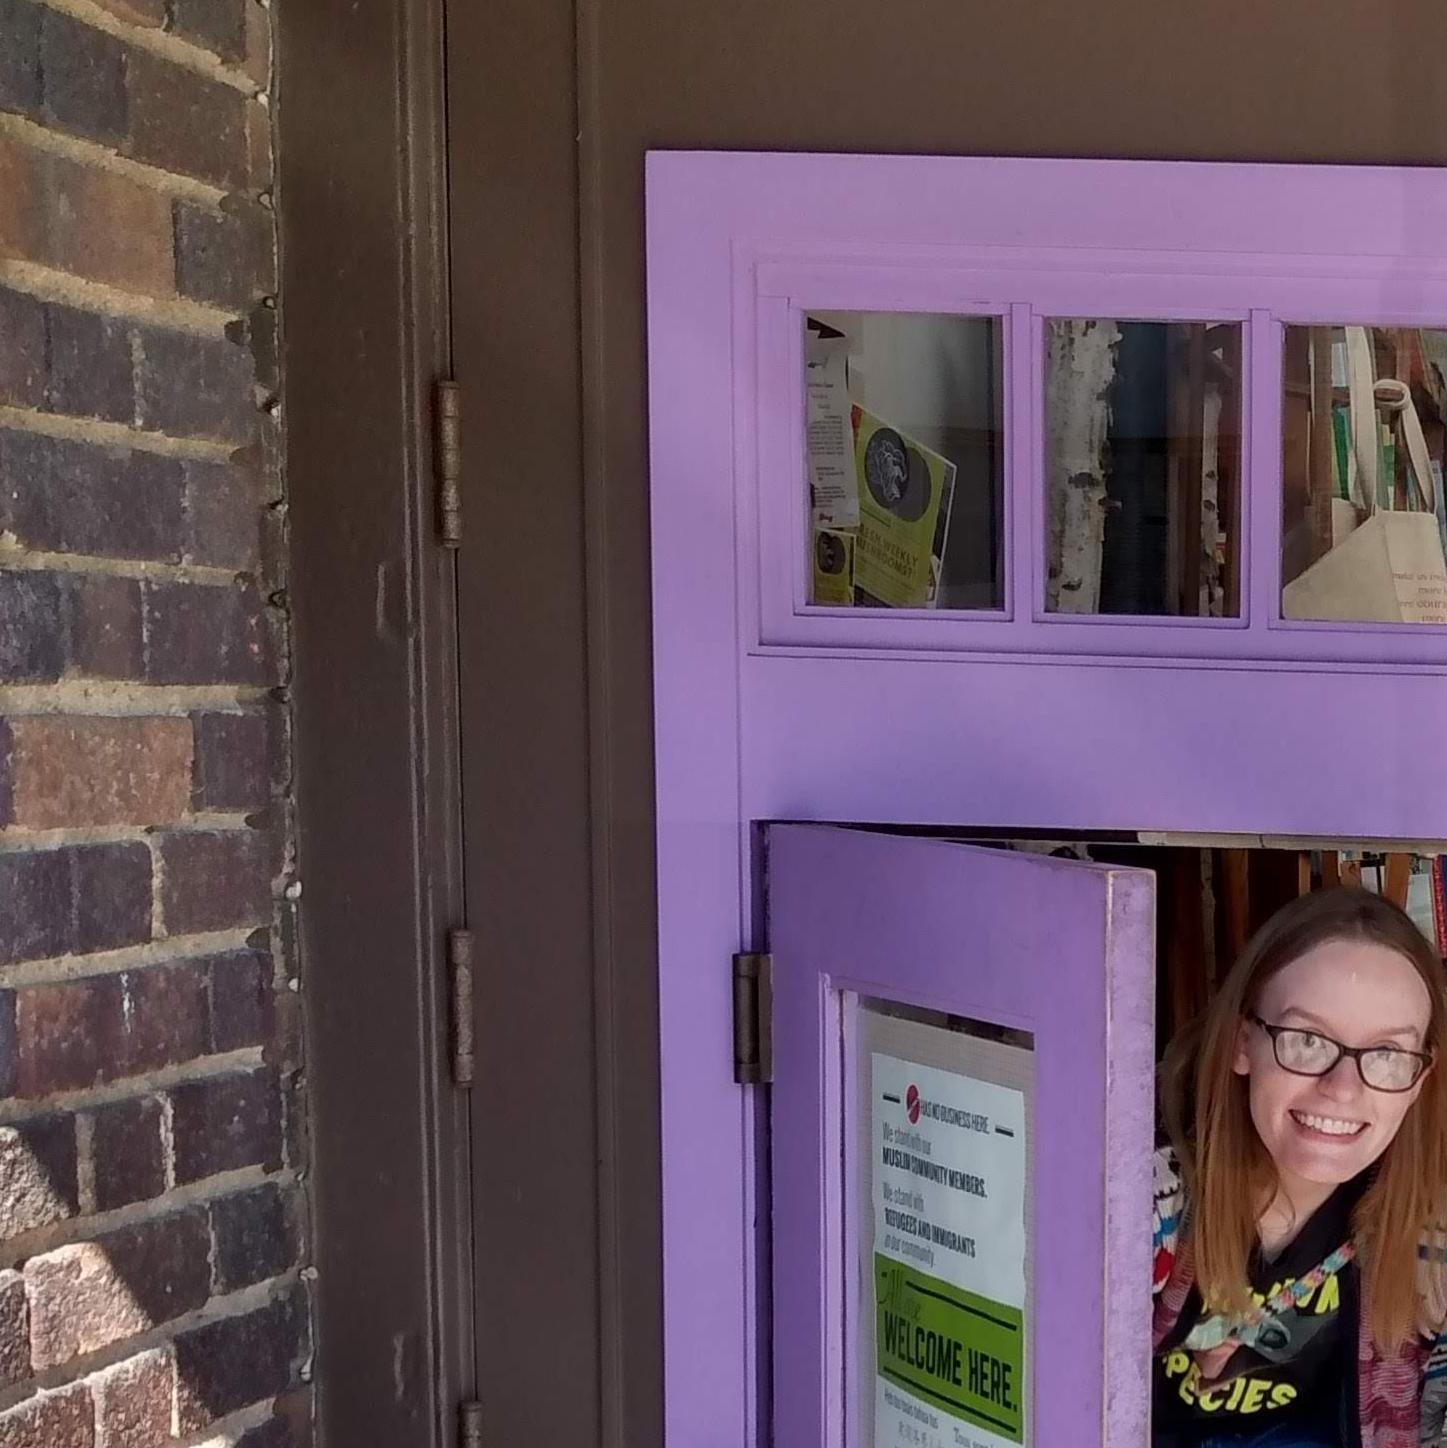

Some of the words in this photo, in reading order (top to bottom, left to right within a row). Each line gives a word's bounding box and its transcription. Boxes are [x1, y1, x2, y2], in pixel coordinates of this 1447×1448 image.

[882, 1121, 893, 1143] We
[940, 1104, 971, 1130] BUSINESS
[882, 1146, 911, 1171] MUSLIM
[911, 1154, 948, 1186] COMMUNITY
[948, 1168, 988, 1199] MEMBERS.
[885, 1207, 918, 1236] REFUGEES
[917, 1218, 931, 1241] AND
[931, 1223, 976, 1259] IMMIGRANTS
[884, 1310, 963, 1388] WELCOME
[967, 1346, 1018, 1413] HERE.
[1161, 1351, 1298, 1414] PECIES
